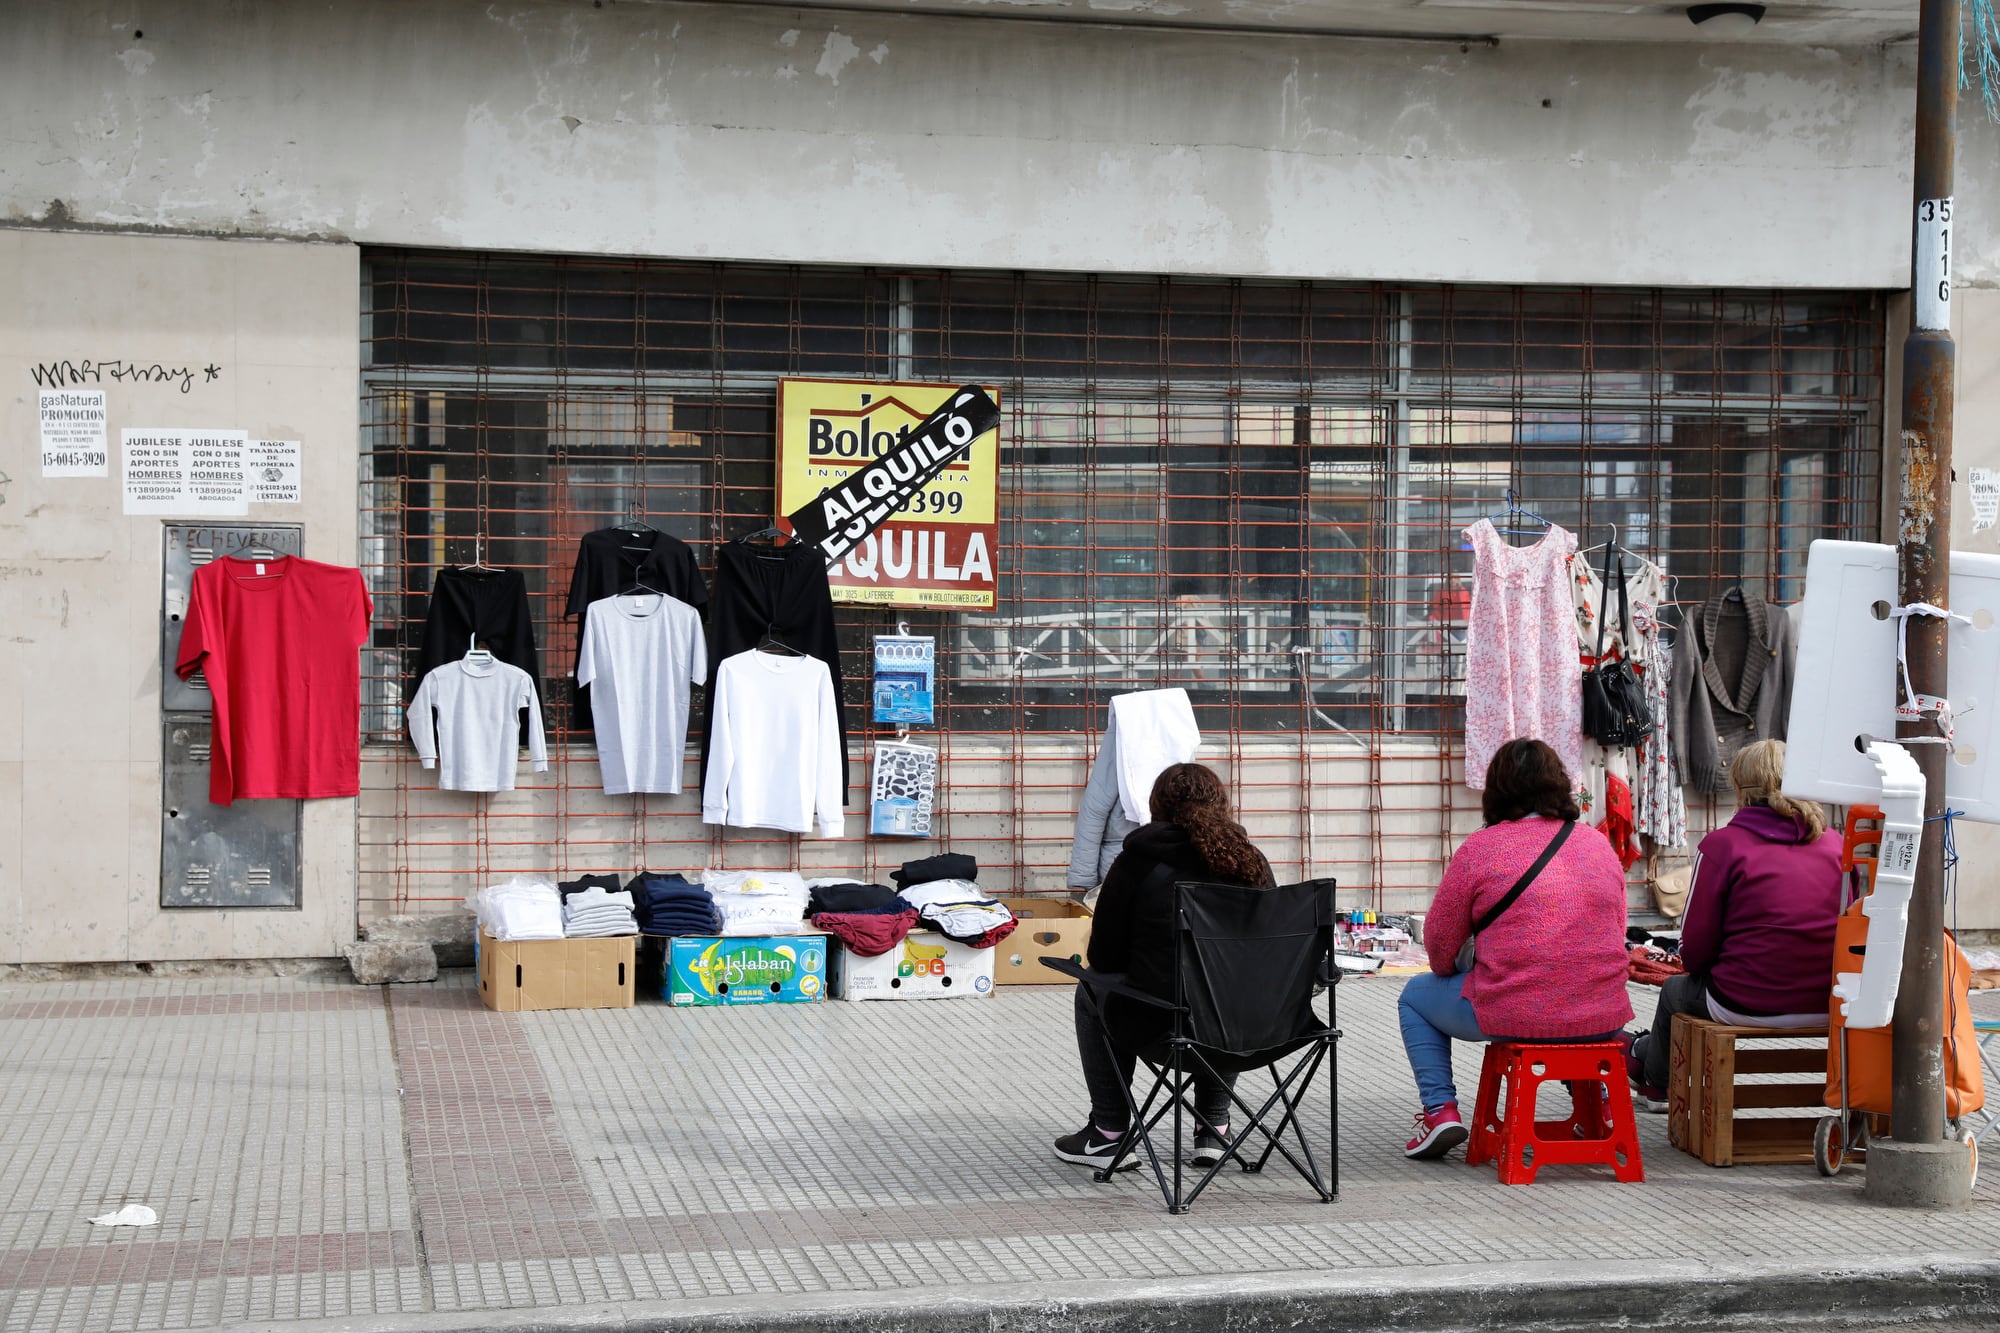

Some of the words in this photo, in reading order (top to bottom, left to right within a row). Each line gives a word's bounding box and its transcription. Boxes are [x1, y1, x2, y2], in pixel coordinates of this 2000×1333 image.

[41, 410, 104, 421] PROMOCION
[126, 438, 182, 446] JUBILESE
[188, 438, 244, 447] JUBILESE
[43, 452, 105, 466] 15-6045-3920
[192, 460, 240, 468] APORTES
[128, 470, 182, 478] HOMBRES
[190, 471, 244, 480] HOMBRES
[724, 950, 792, 985] Islaban
